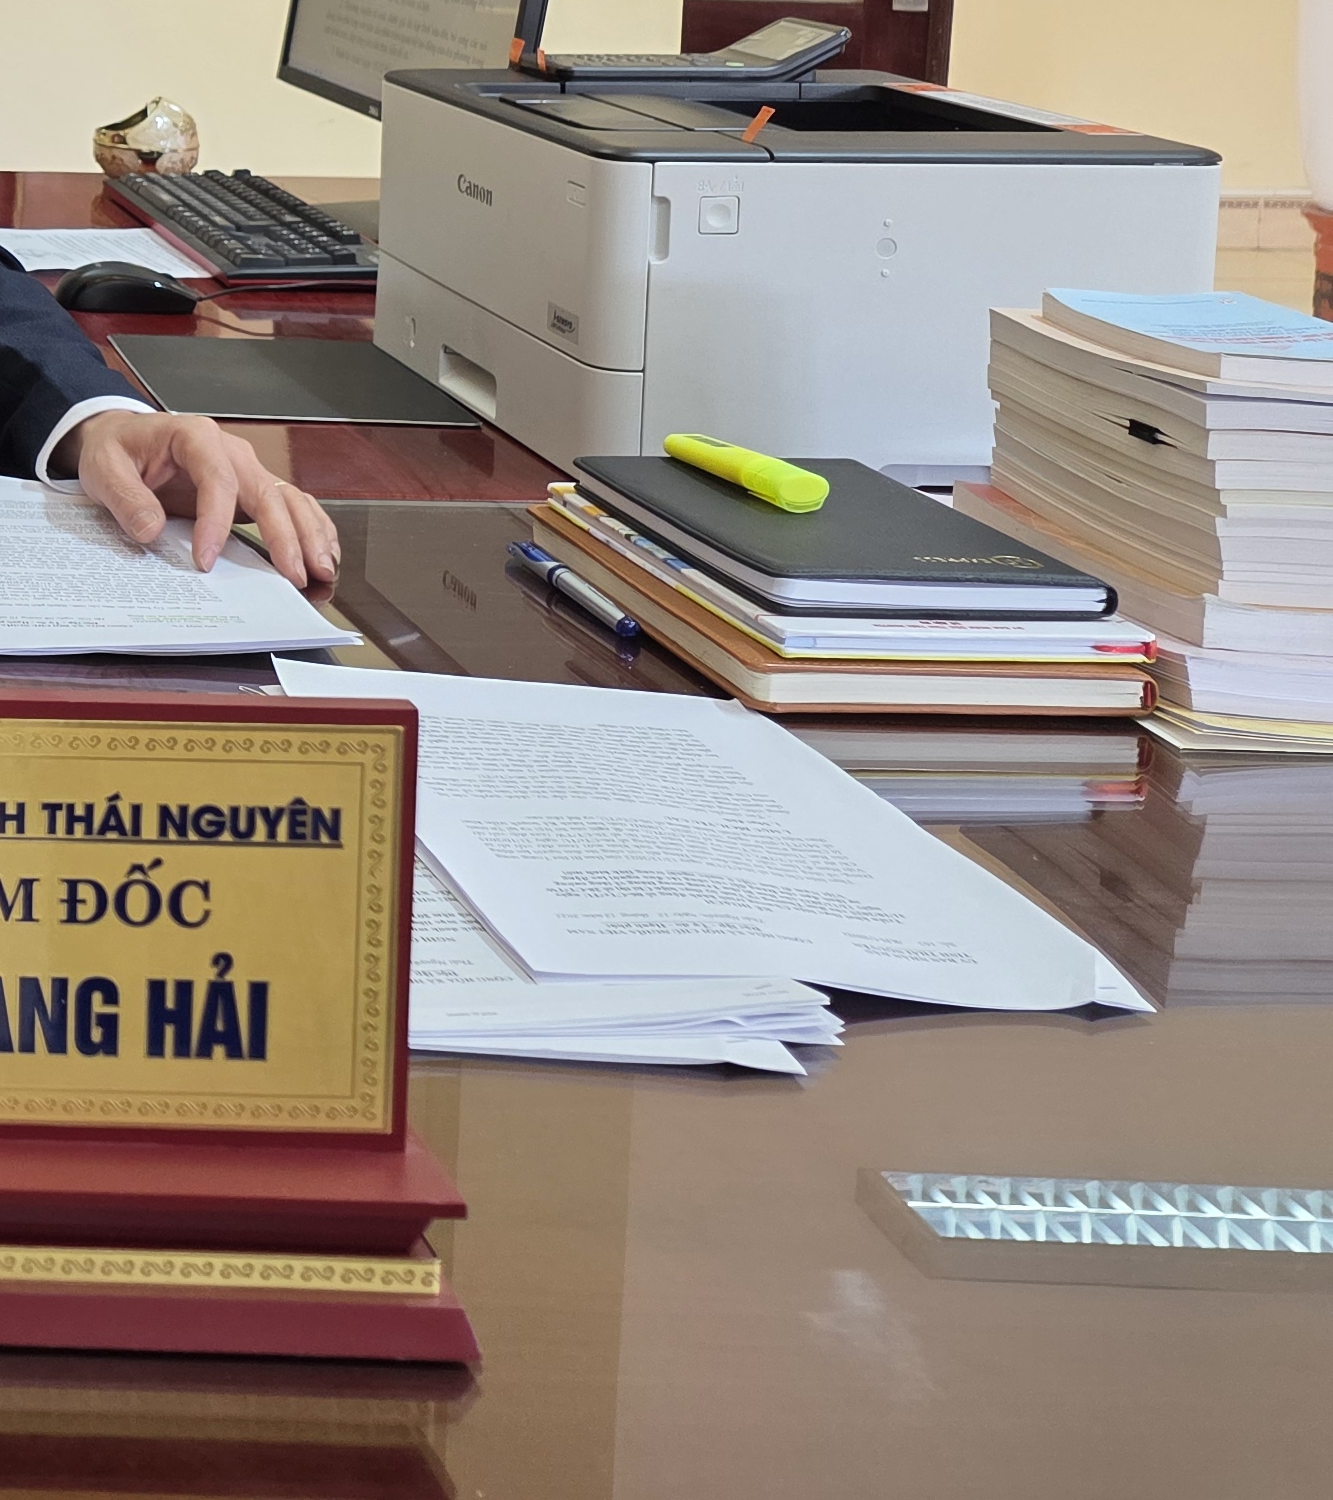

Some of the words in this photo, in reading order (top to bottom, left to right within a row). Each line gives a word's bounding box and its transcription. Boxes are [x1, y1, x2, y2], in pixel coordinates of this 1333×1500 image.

[457, 173, 493, 206] Canon
[41, 791, 143, 838] THÁI
[157, 796, 342, 842] NGUYÊN
[58, 856, 212, 929] ĐỐC
[146, 951, 269, 1062] HẢI
